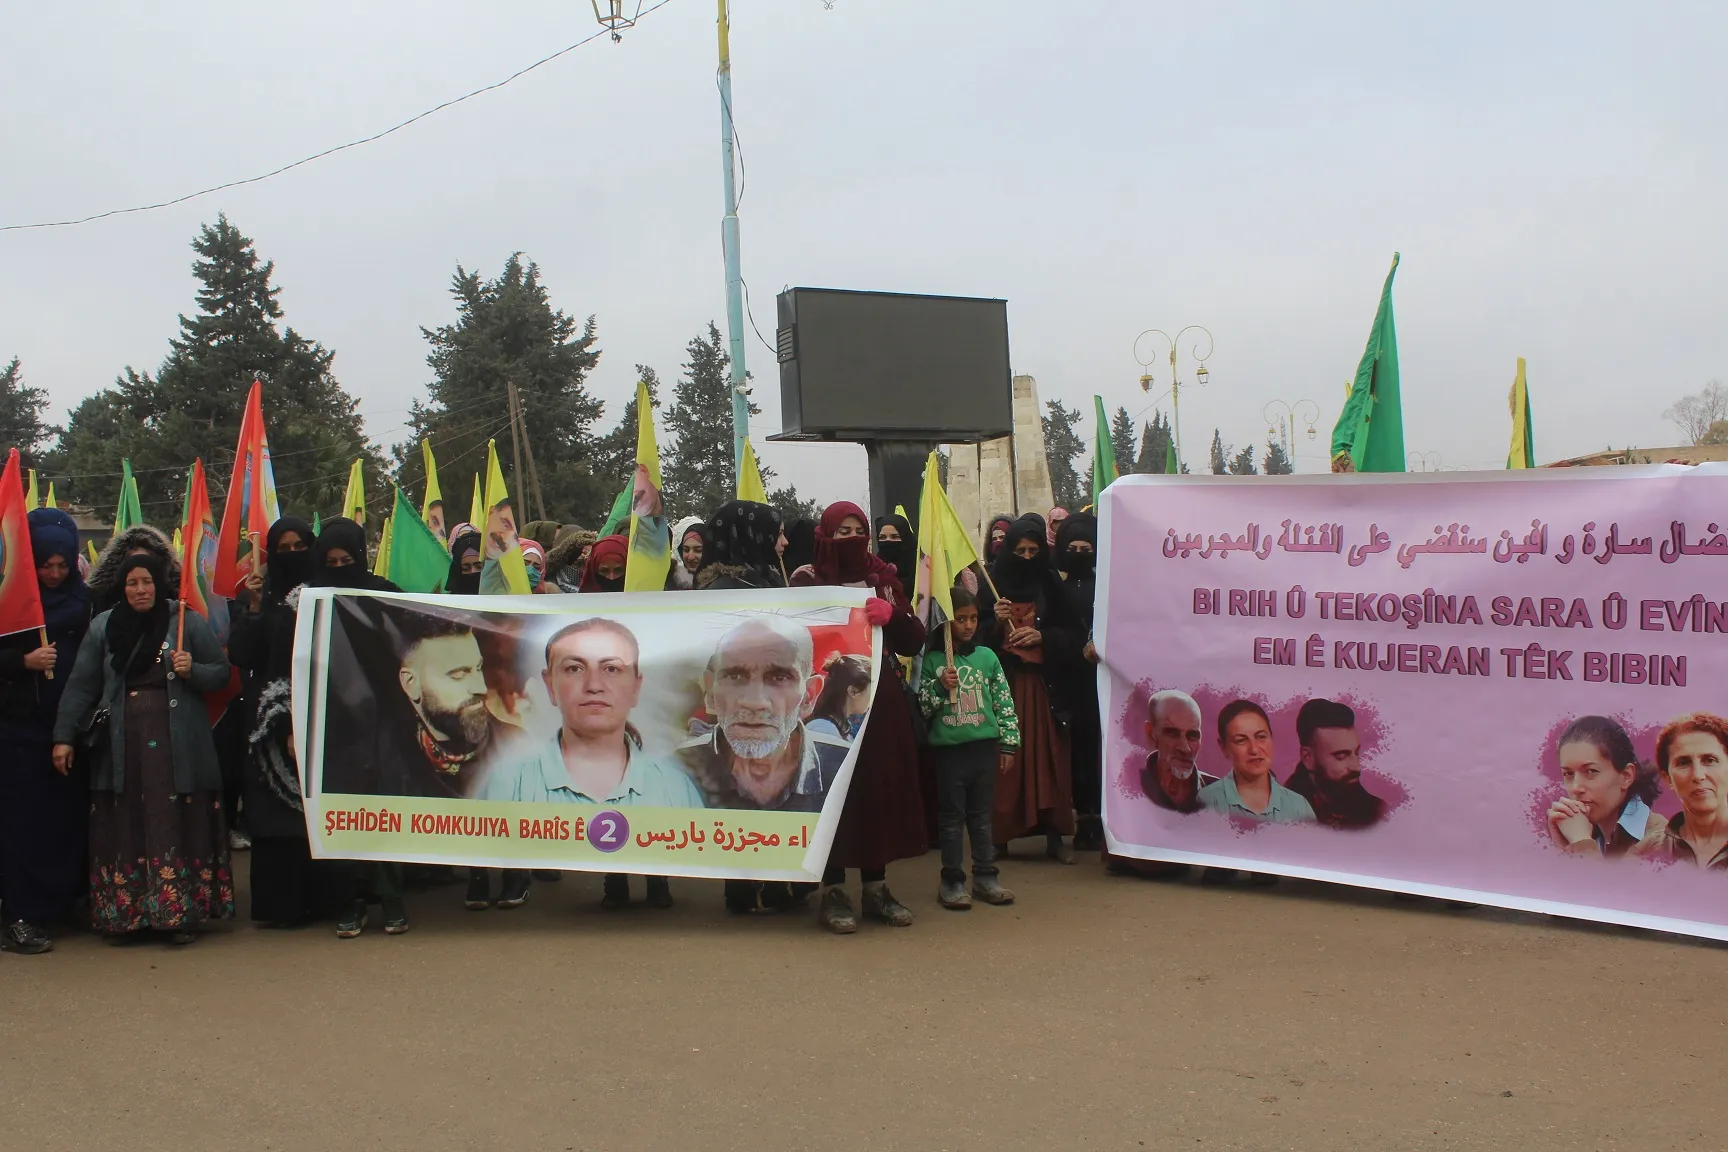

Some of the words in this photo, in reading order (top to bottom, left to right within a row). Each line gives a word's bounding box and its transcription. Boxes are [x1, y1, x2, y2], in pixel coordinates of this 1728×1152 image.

[1162, 522, 1272, 560] والمجرمين
[1277, 518, 1344, 554] القتلة
[1348, 523, 1391, 567] على
[1397, 522, 1487, 569] سنقضي
[1493, 518, 1548, 564] افين
[1555, 534, 1575, 564] و
[1582, 521, 1653, 564] سارة
[1660, 520, 1728, 564] ضال
[1193, 587, 1221, 616] BI
[1229, 588, 1277, 618] RIH
[1287, 584, 1307, 619] Û
[1315, 587, 1483, 630] TEKOŞÎNA
[1491, 595, 1593, 629] SARA
[1602, 591, 1628, 631] Û
[1254, 636, 1296, 667] EM
[1305, 633, 1325, 668] Ê
[1334, 640, 1490, 677] KUJERAN
[1500, 642, 1573, 681] TÊK
[1584, 651, 1687, 687] BIBIN
[325, 807, 402, 836] ŞEHÎDÊN
[410, 813, 510, 838] KOMKUJIYA
[519, 816, 570, 841] BARÎS
[574, 816, 585, 841] Ê
[599, 819, 617, 842] 2
[635, 820, 706, 851] باريس
[713, 821, 781, 853] مجزرة
